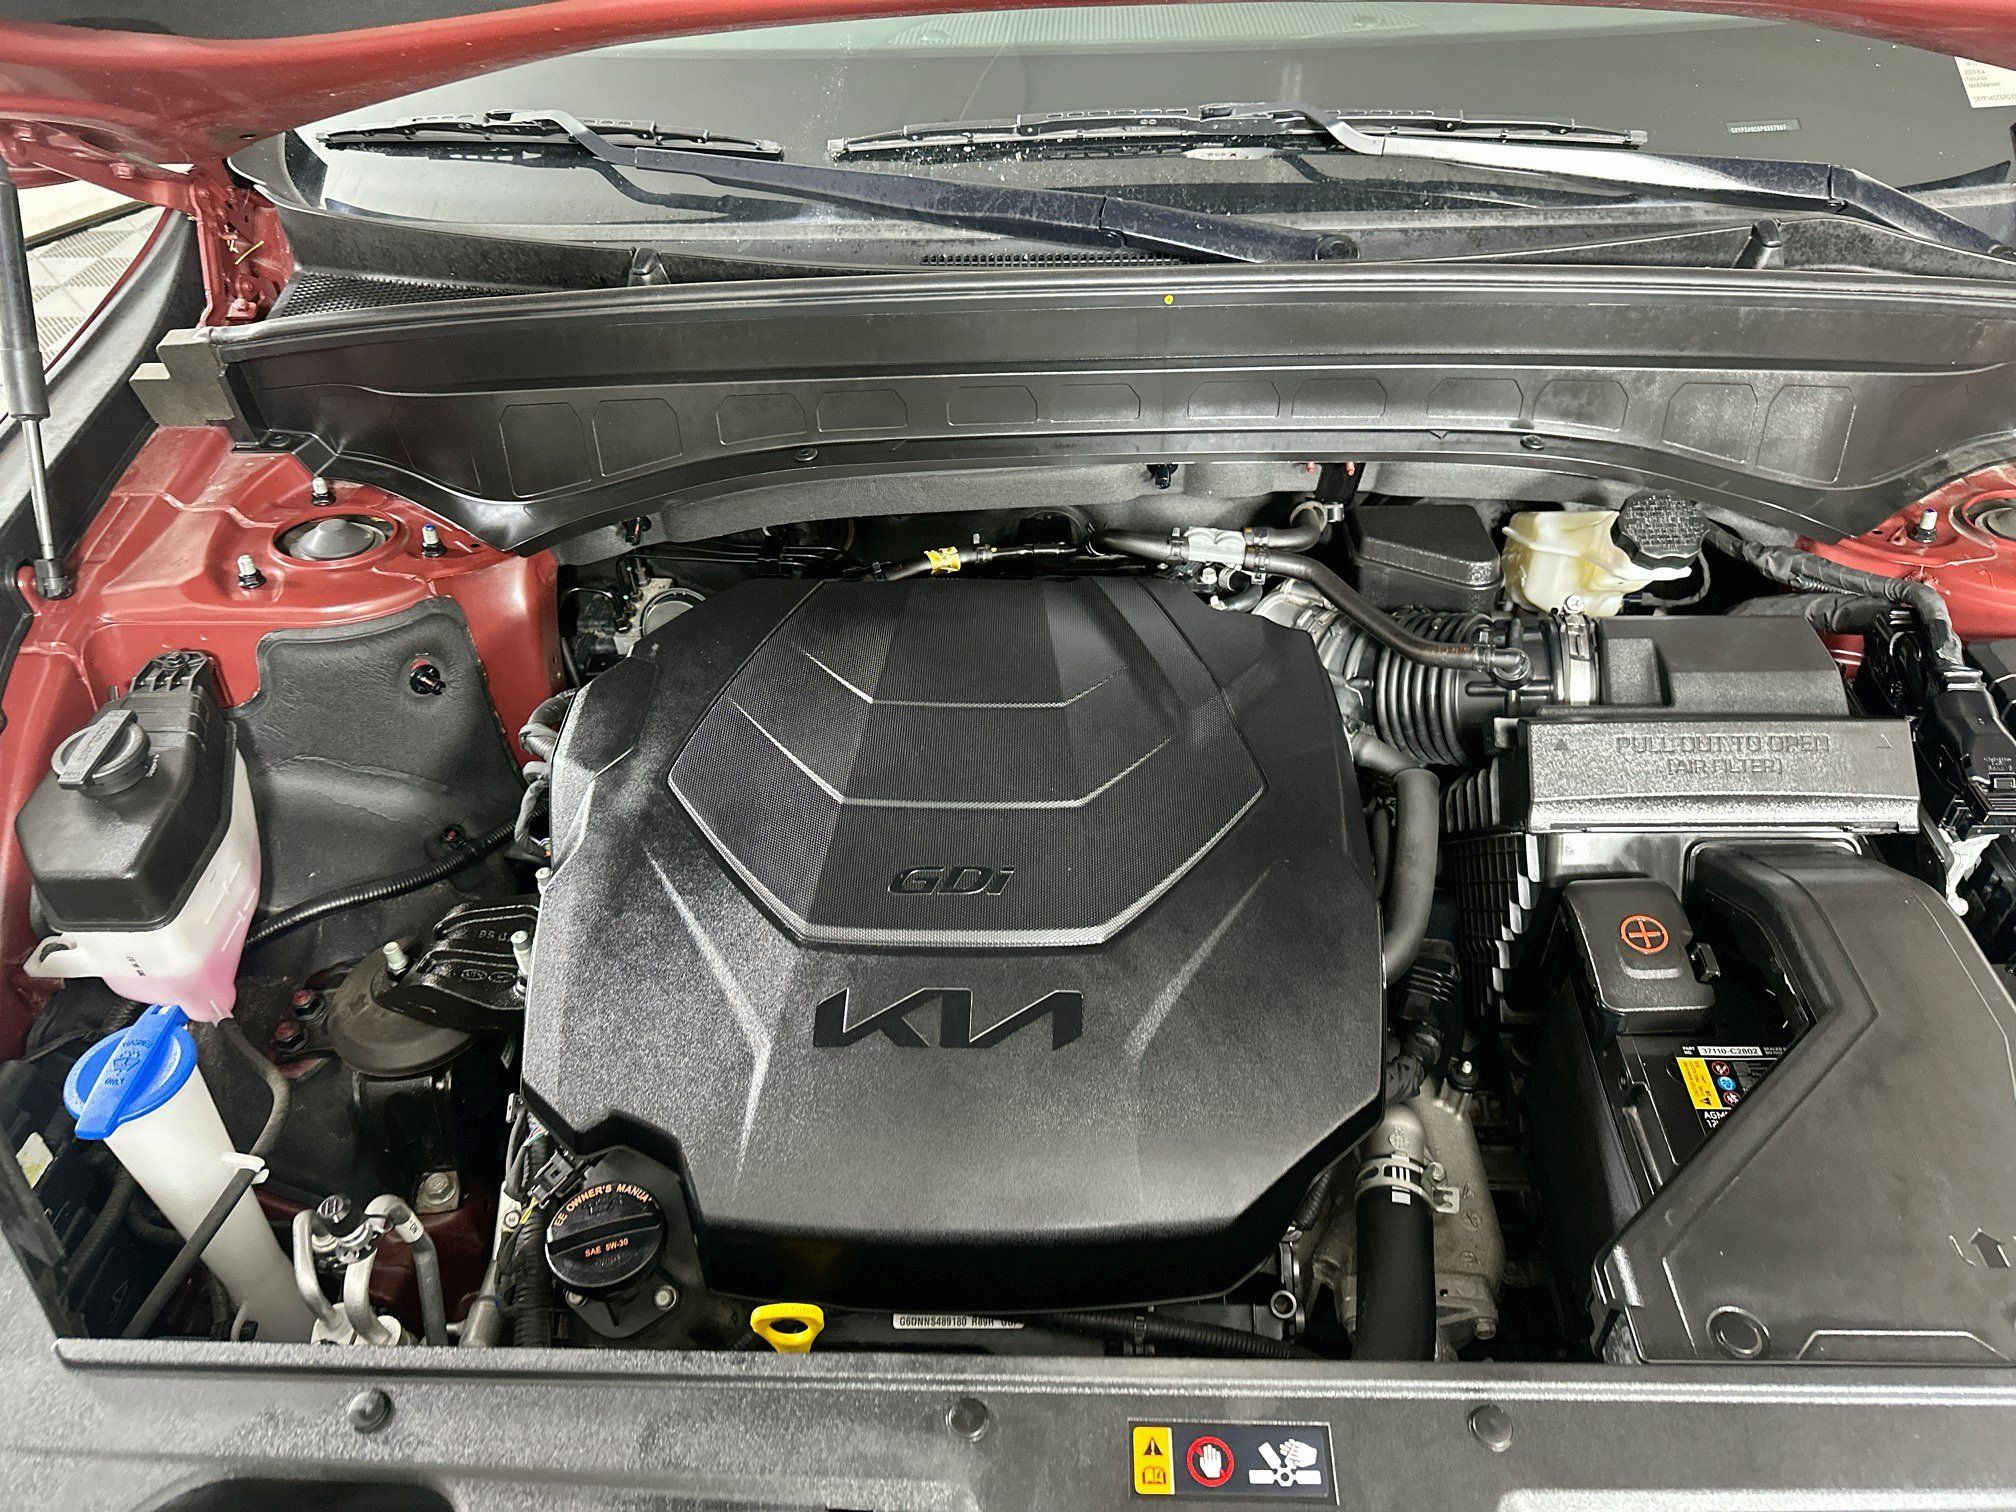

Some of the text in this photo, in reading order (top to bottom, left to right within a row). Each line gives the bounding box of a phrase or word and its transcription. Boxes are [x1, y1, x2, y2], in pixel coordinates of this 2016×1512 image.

[1616, 734, 1829, 752] PULL OUT TO OPEN
[887, 866, 1016, 896] GDi
[1701, 1047, 1759, 1055] 37110-C2802
[1704, 1111, 1728, 1120] AGM
[1706, 1119, 1719, 1128] 12
[566, 1184, 612, 1212] OWNER'S
[584, 1237, 629, 1258] SAE 5W-30
